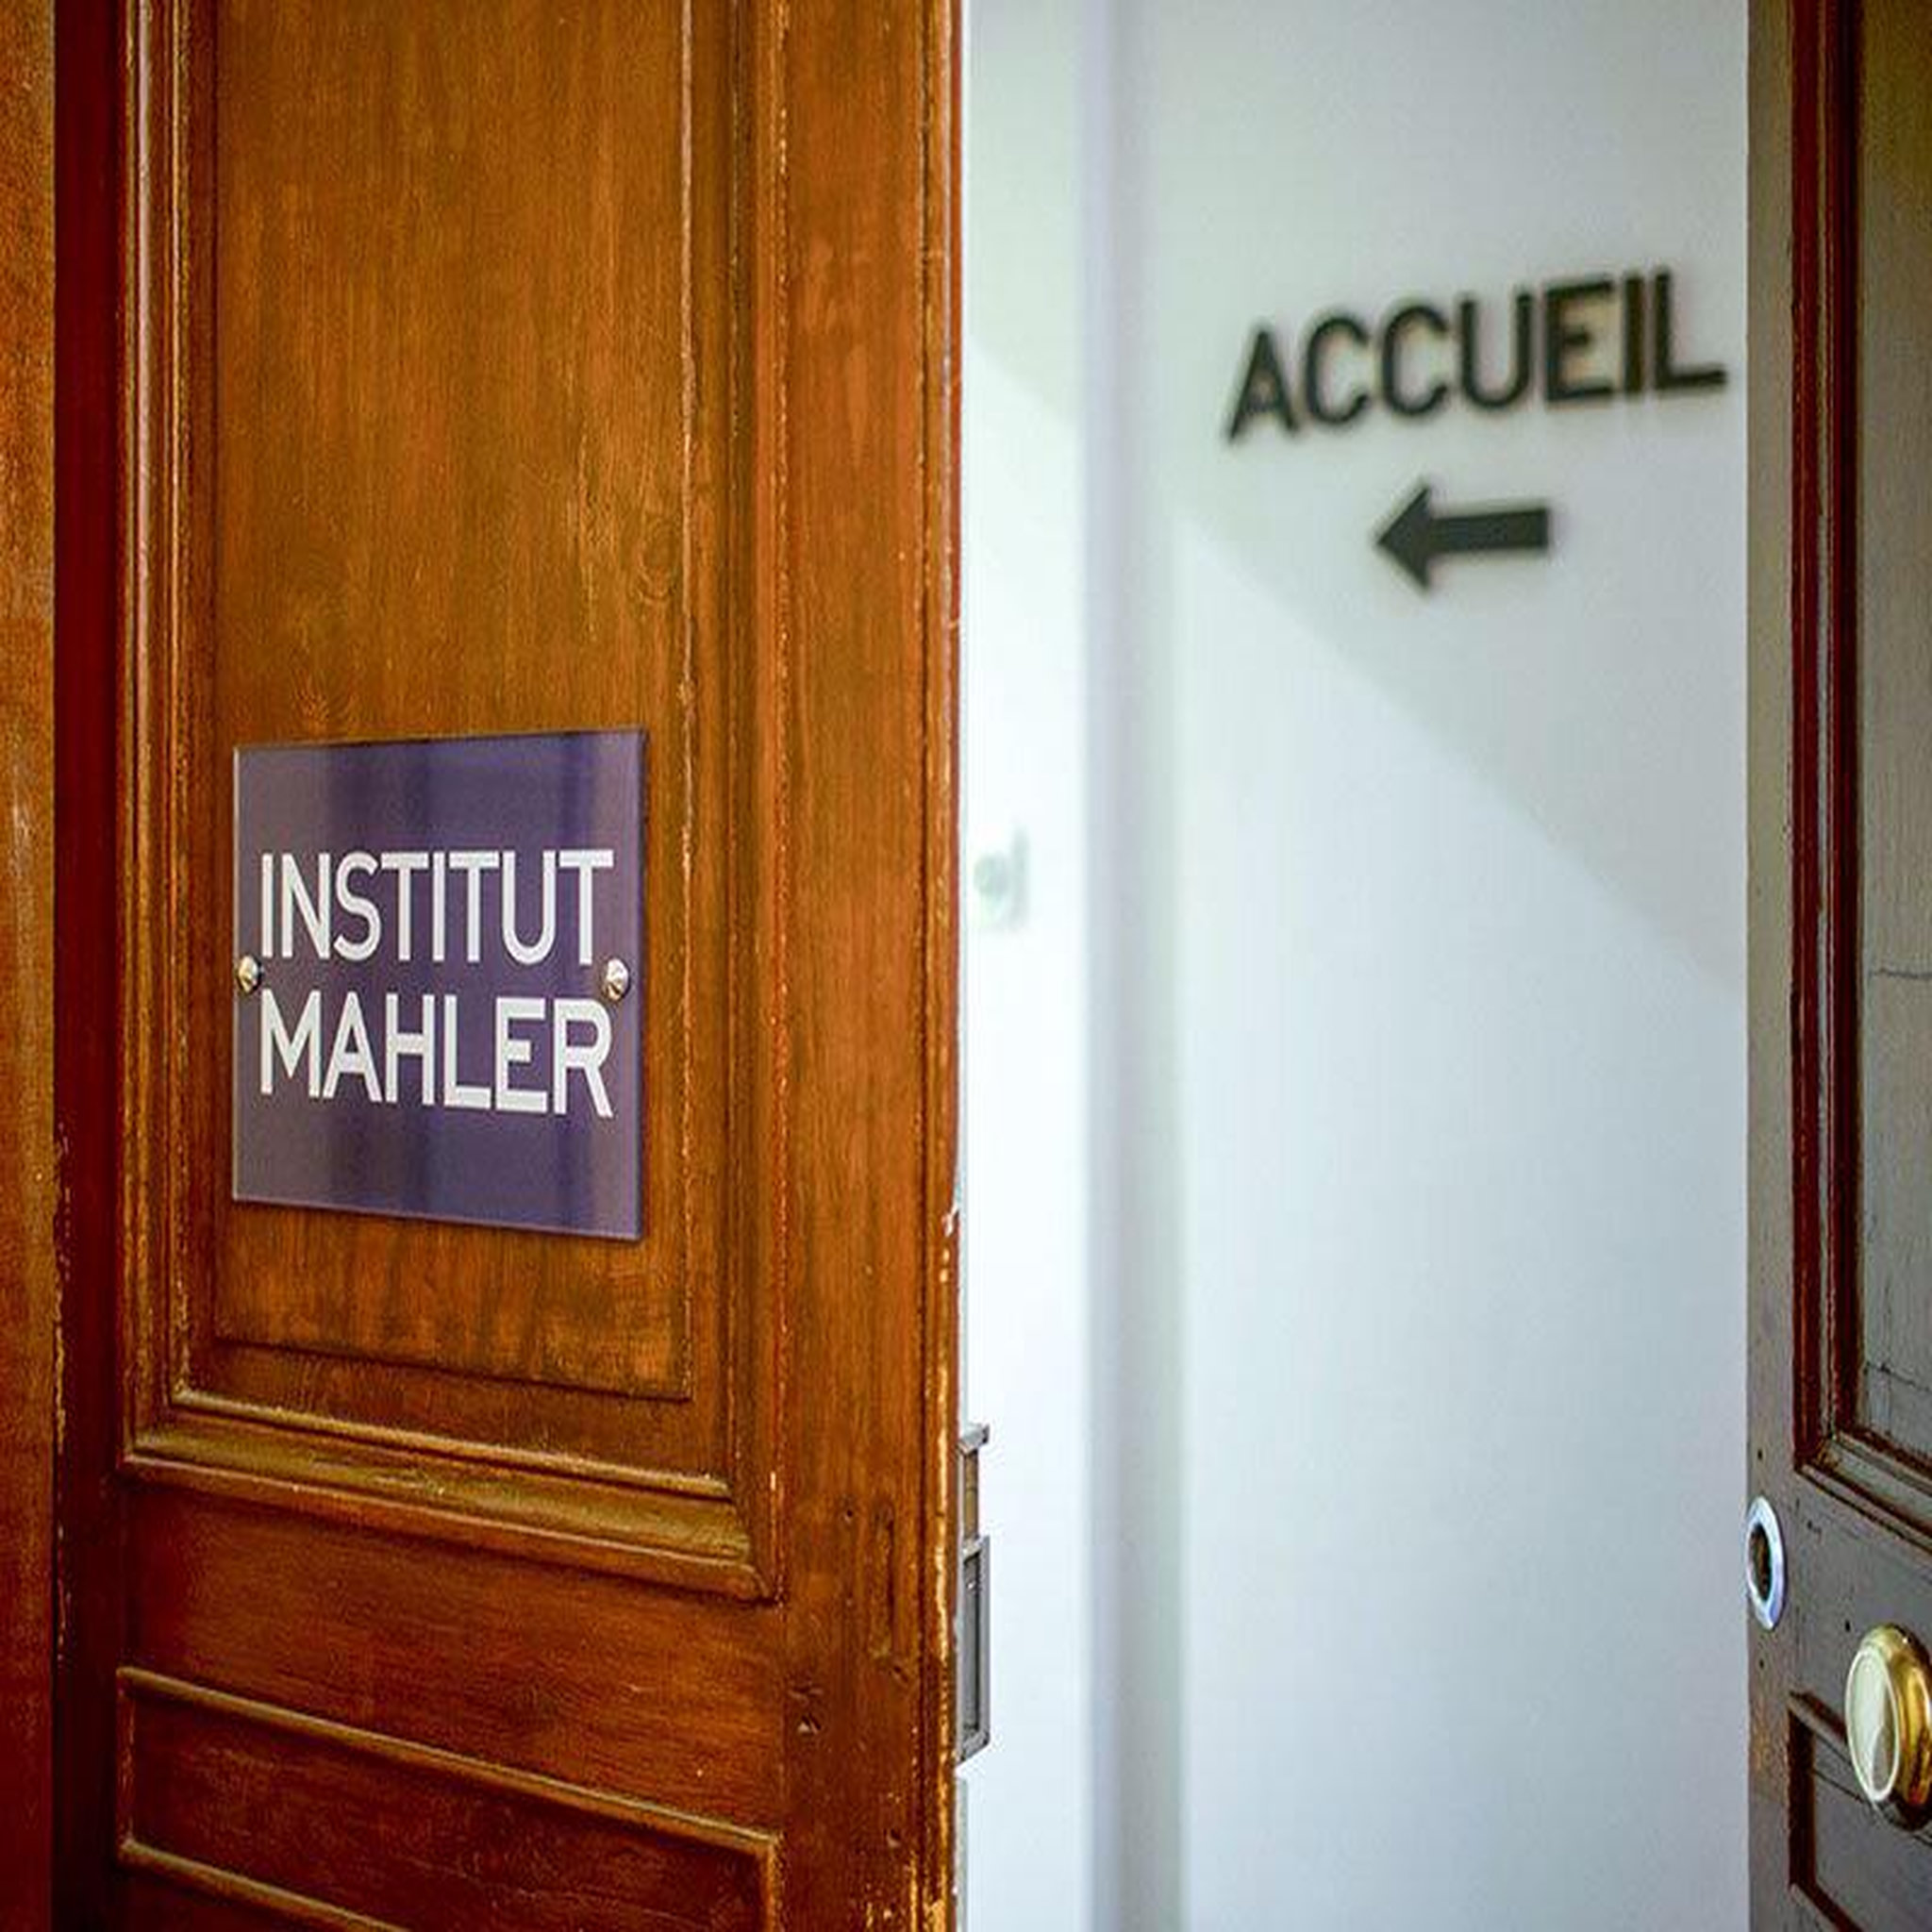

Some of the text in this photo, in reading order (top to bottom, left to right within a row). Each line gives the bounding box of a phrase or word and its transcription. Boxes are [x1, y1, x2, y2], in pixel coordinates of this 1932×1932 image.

[1226, 266, 1729, 441] ACCUEIL
[261, 849, 614, 966] INSTITUT
[260, 989, 614, 1119] MAHLER
